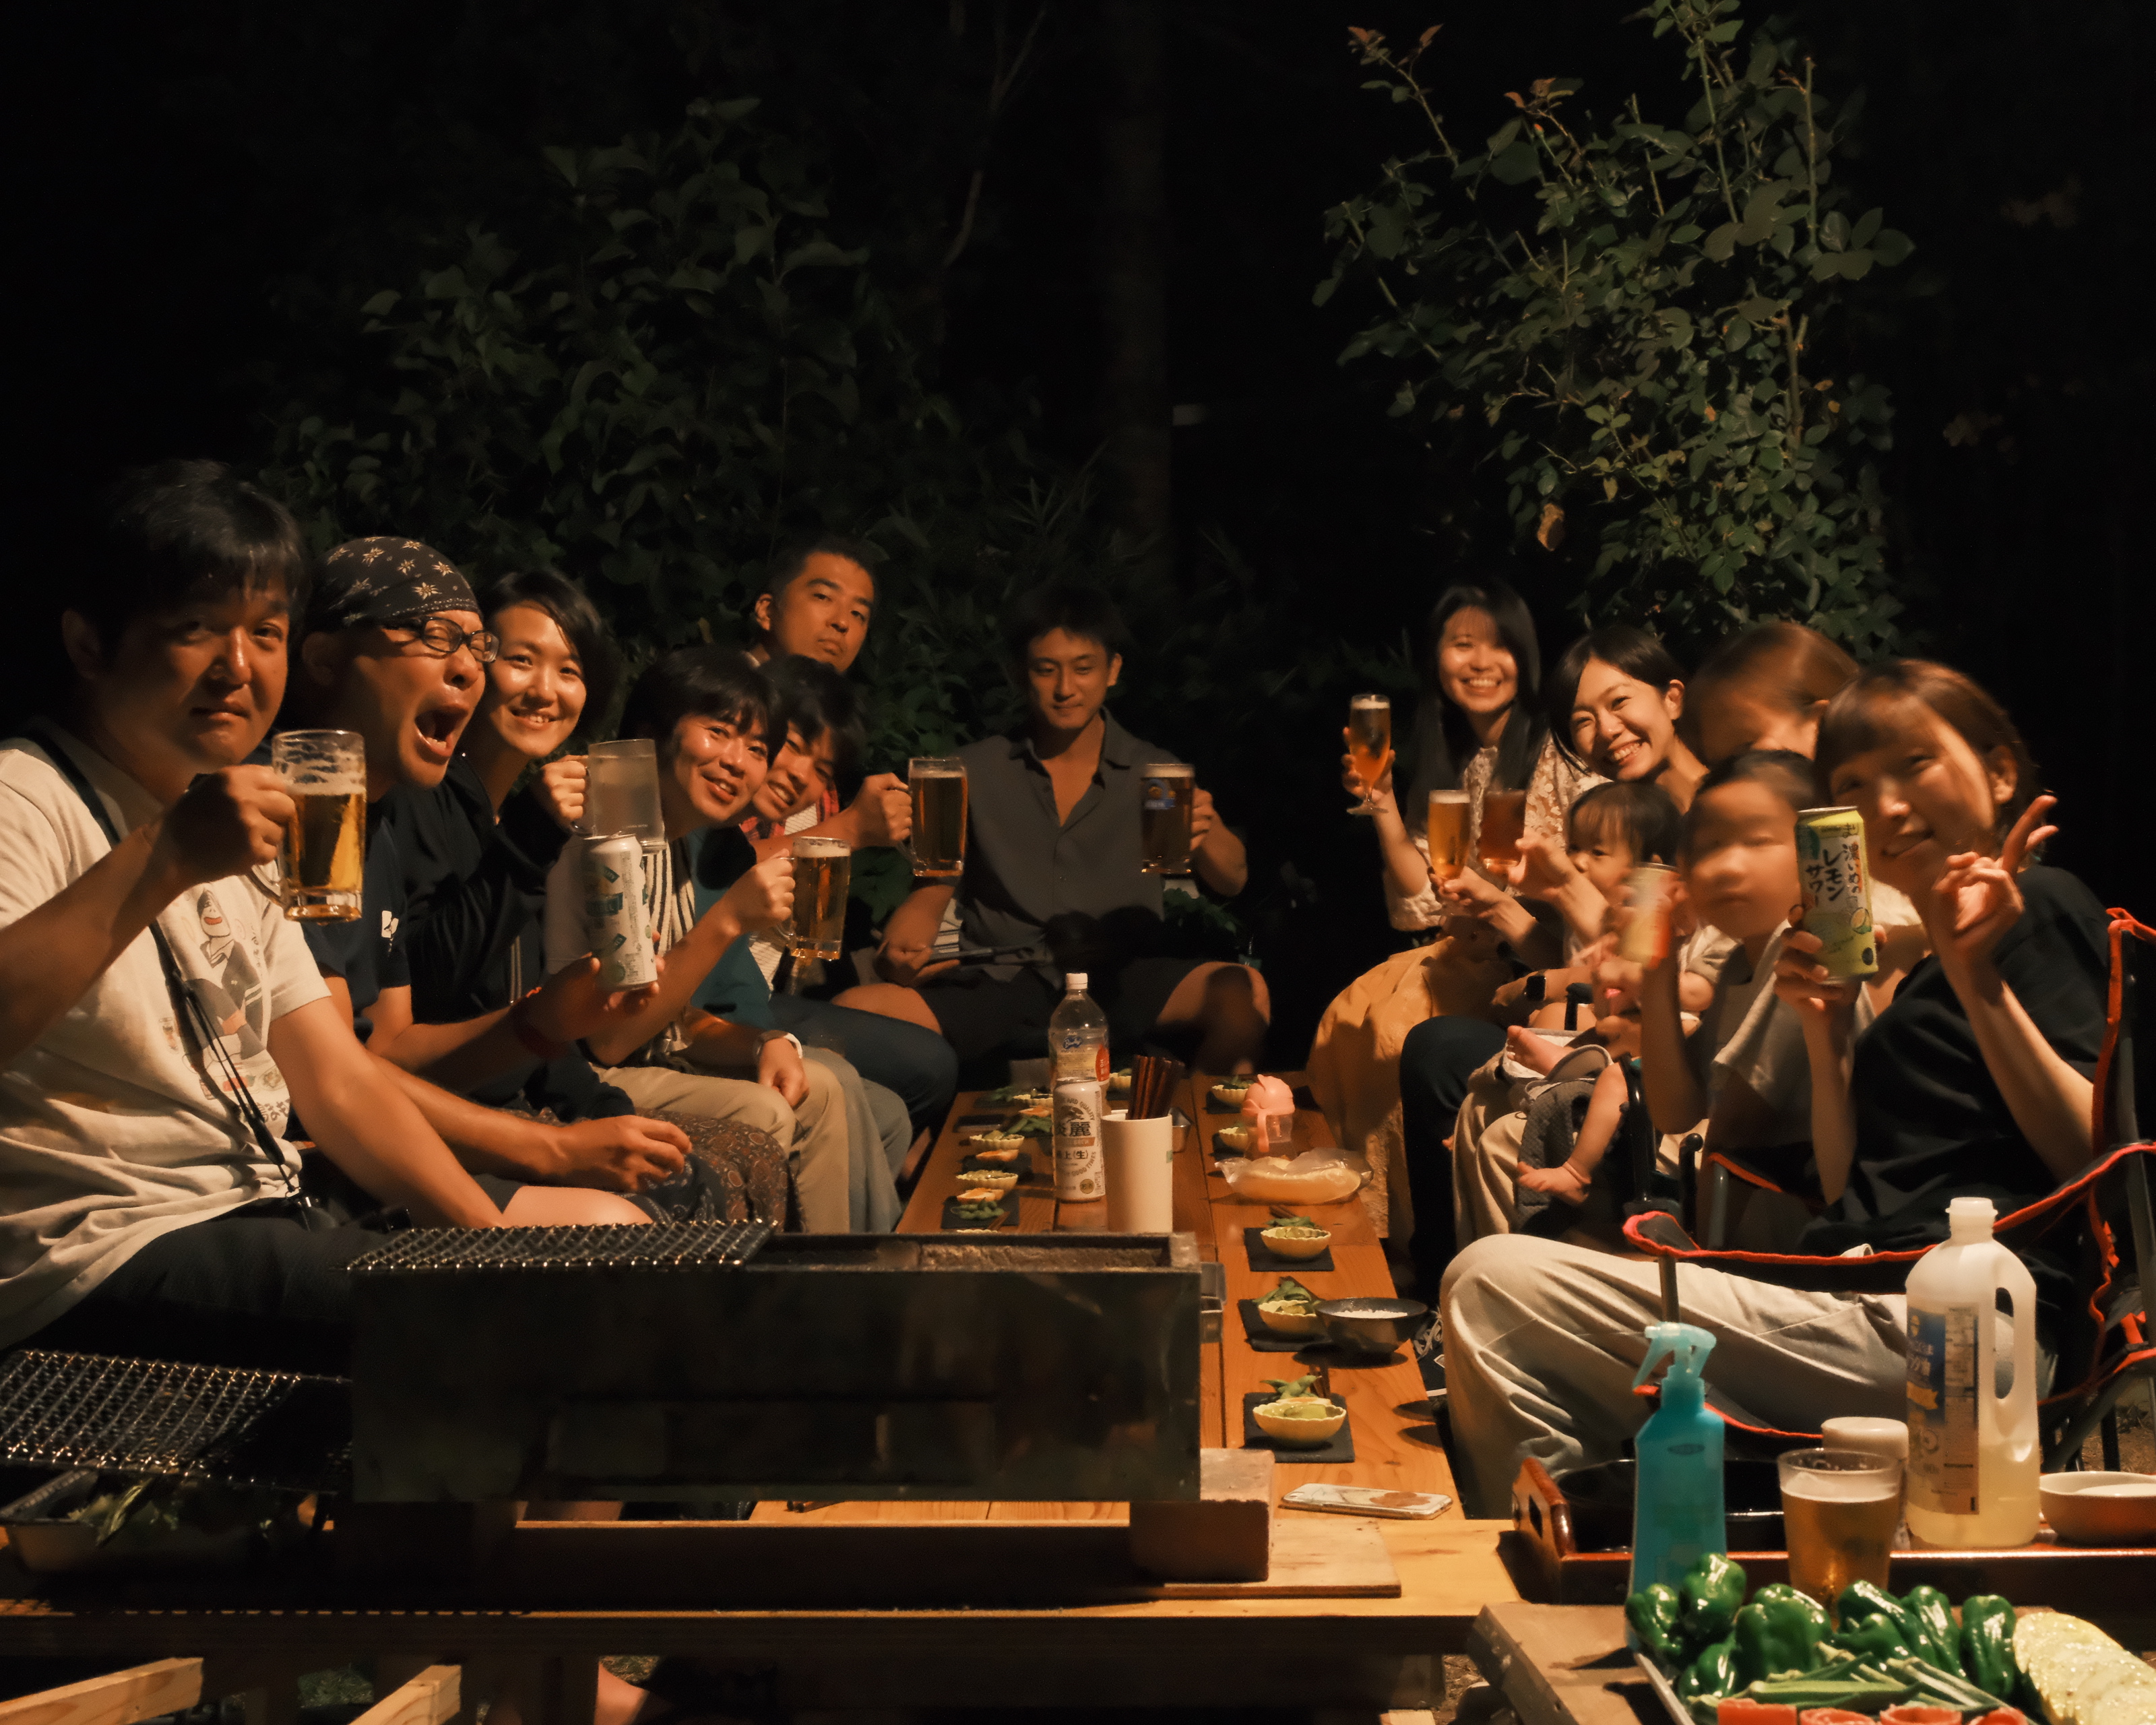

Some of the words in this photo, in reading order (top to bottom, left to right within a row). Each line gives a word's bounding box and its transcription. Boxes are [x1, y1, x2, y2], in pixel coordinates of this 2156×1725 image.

[1806, 863, 1825, 907] サワー
[1822, 848, 1845, 902] レモン
